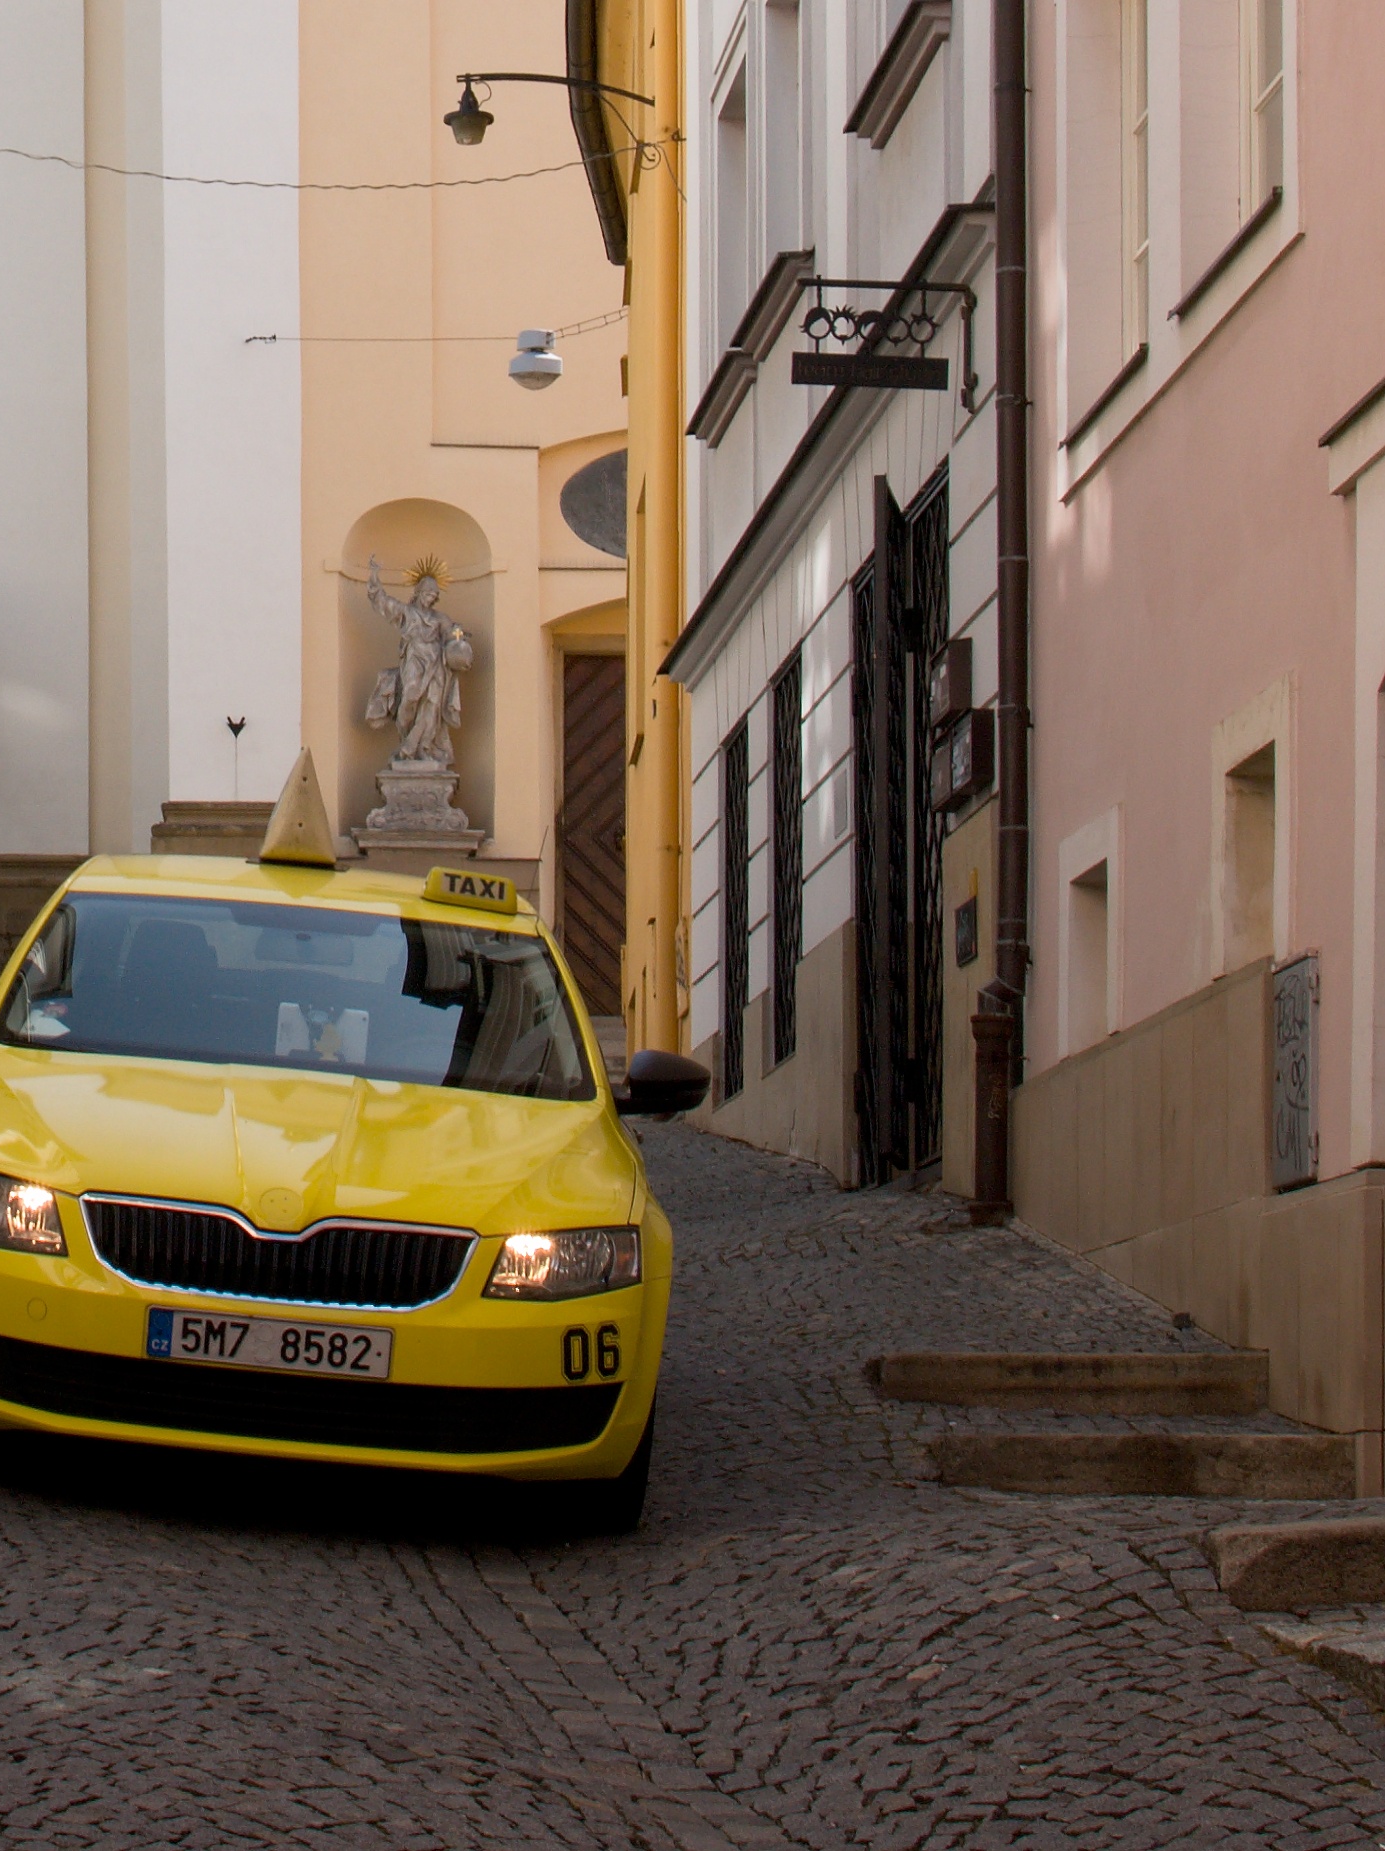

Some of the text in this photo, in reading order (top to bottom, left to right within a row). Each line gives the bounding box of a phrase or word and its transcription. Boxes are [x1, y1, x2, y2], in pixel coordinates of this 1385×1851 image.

[443, 872, 506, 900] TAXI
[151, 1338, 168, 1352] CZ
[181, 1317, 372, 1371] 5M7 8582
[560, 1321, 620, 1383] 06
